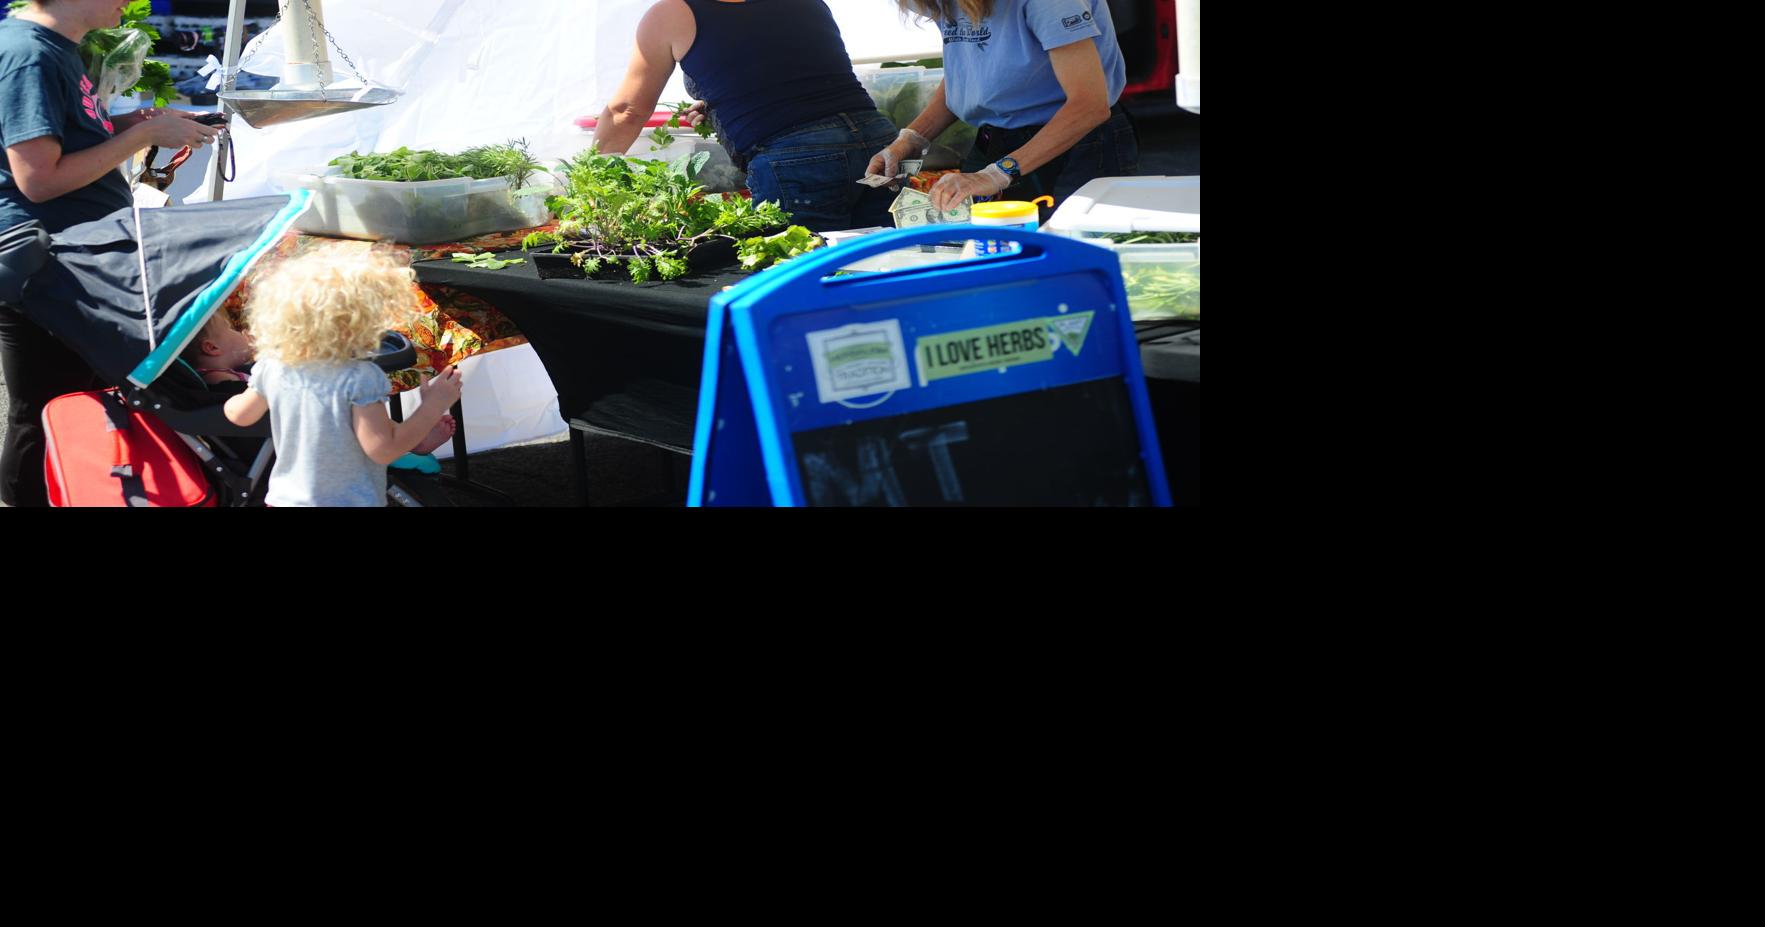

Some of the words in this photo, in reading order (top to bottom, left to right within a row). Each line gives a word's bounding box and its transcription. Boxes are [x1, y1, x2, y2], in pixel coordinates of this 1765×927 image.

[925, 345, 934, 368] I
[936, 336, 983, 367] LOVE
[986, 326, 1047, 358] HERBS
